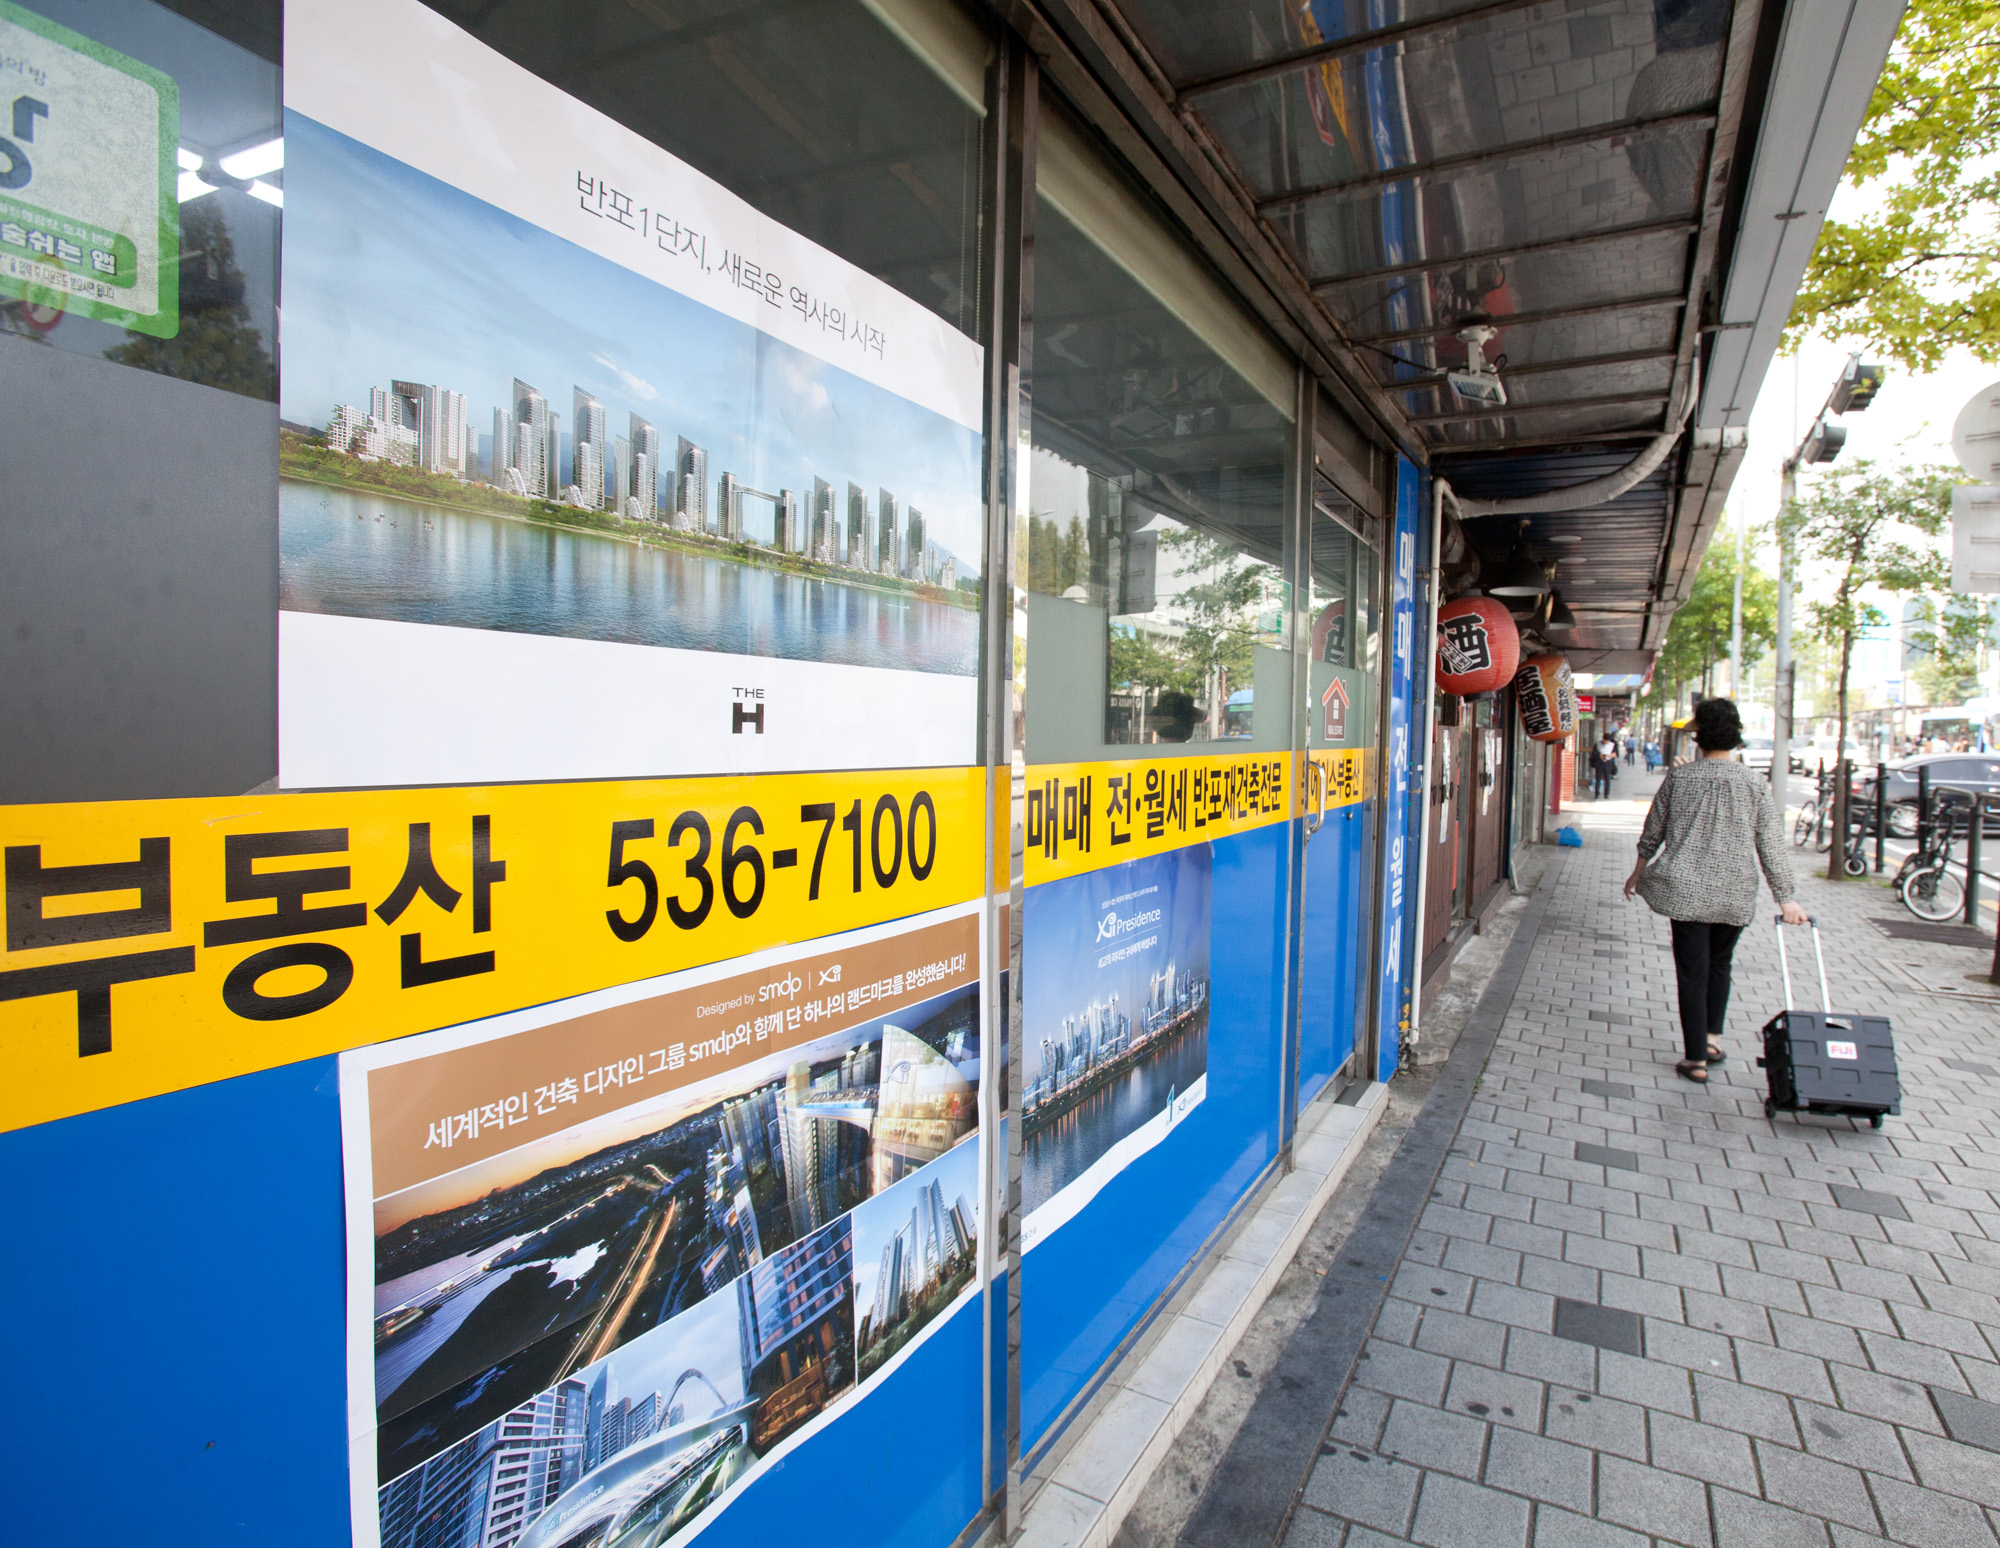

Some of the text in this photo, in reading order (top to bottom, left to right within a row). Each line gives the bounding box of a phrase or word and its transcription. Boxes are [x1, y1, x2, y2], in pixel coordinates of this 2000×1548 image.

[91, 249, 117, 276] 앱
[577, 170, 887, 360] 반포1단지, 새로운 역사의 시작
[1397, 530, 1415, 681] 매매
[732, 687, 764, 699] THE
[732, 702, 764, 734] H
[1027, 775, 1092, 860] 매매
[1194, 762, 1282, 828] 반포재건축전문
[605, 791, 937, 942] 536-7100
[0, 815, 506, 1059] 부동산
[1117, 908, 1161, 935] Presidence
[697, 997, 742, 1019] Designed
[745, 994, 755, 1006] by
[758, 972, 803, 1001] smdp
[424, 952, 967, 1149] 세계적인 건축 디자인 그룹 smdp와 함께 단 하나의 랜드마크를 완성했습니다!
